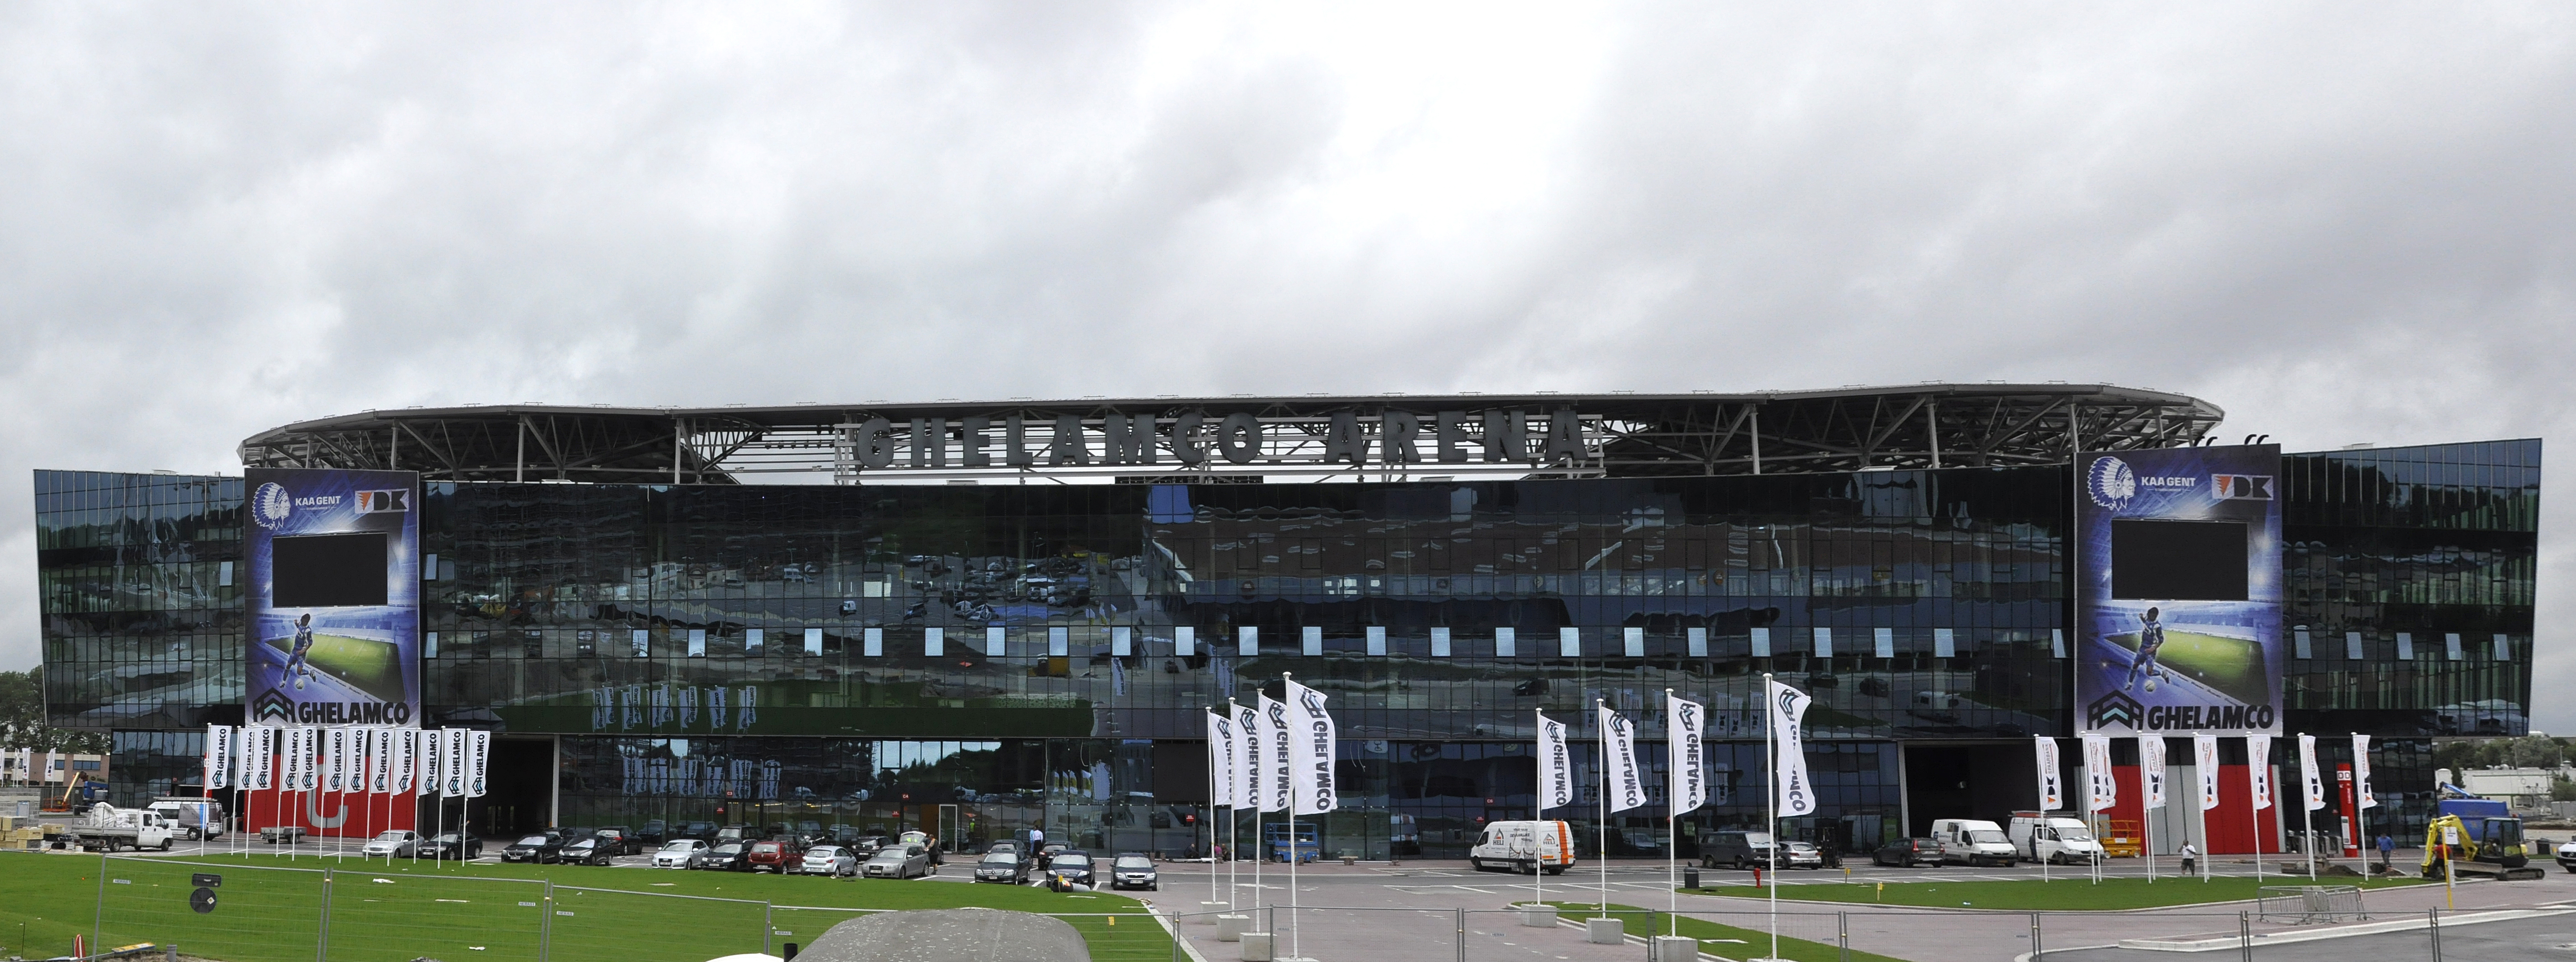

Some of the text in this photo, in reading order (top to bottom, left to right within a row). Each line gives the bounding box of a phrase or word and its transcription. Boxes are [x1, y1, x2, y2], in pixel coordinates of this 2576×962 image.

[857, 409, 1589, 468] GHELAMCO ARENA
[296, 496, 340, 506] KAA GENT
[2142, 476, 2196, 487] KAA GENT
[298, 701, 410, 724] GHELAMCO
[2148, 704, 2275, 730] GHELAMCO
[218, 728, 227, 769] GHELAMCO
[262, 729, 270, 770] GHELAMCO
[380, 732, 389, 773] GHELAMCO
[452, 731, 461, 775] GHELAMCO
[476, 734, 485, 776] GHELAMCO
